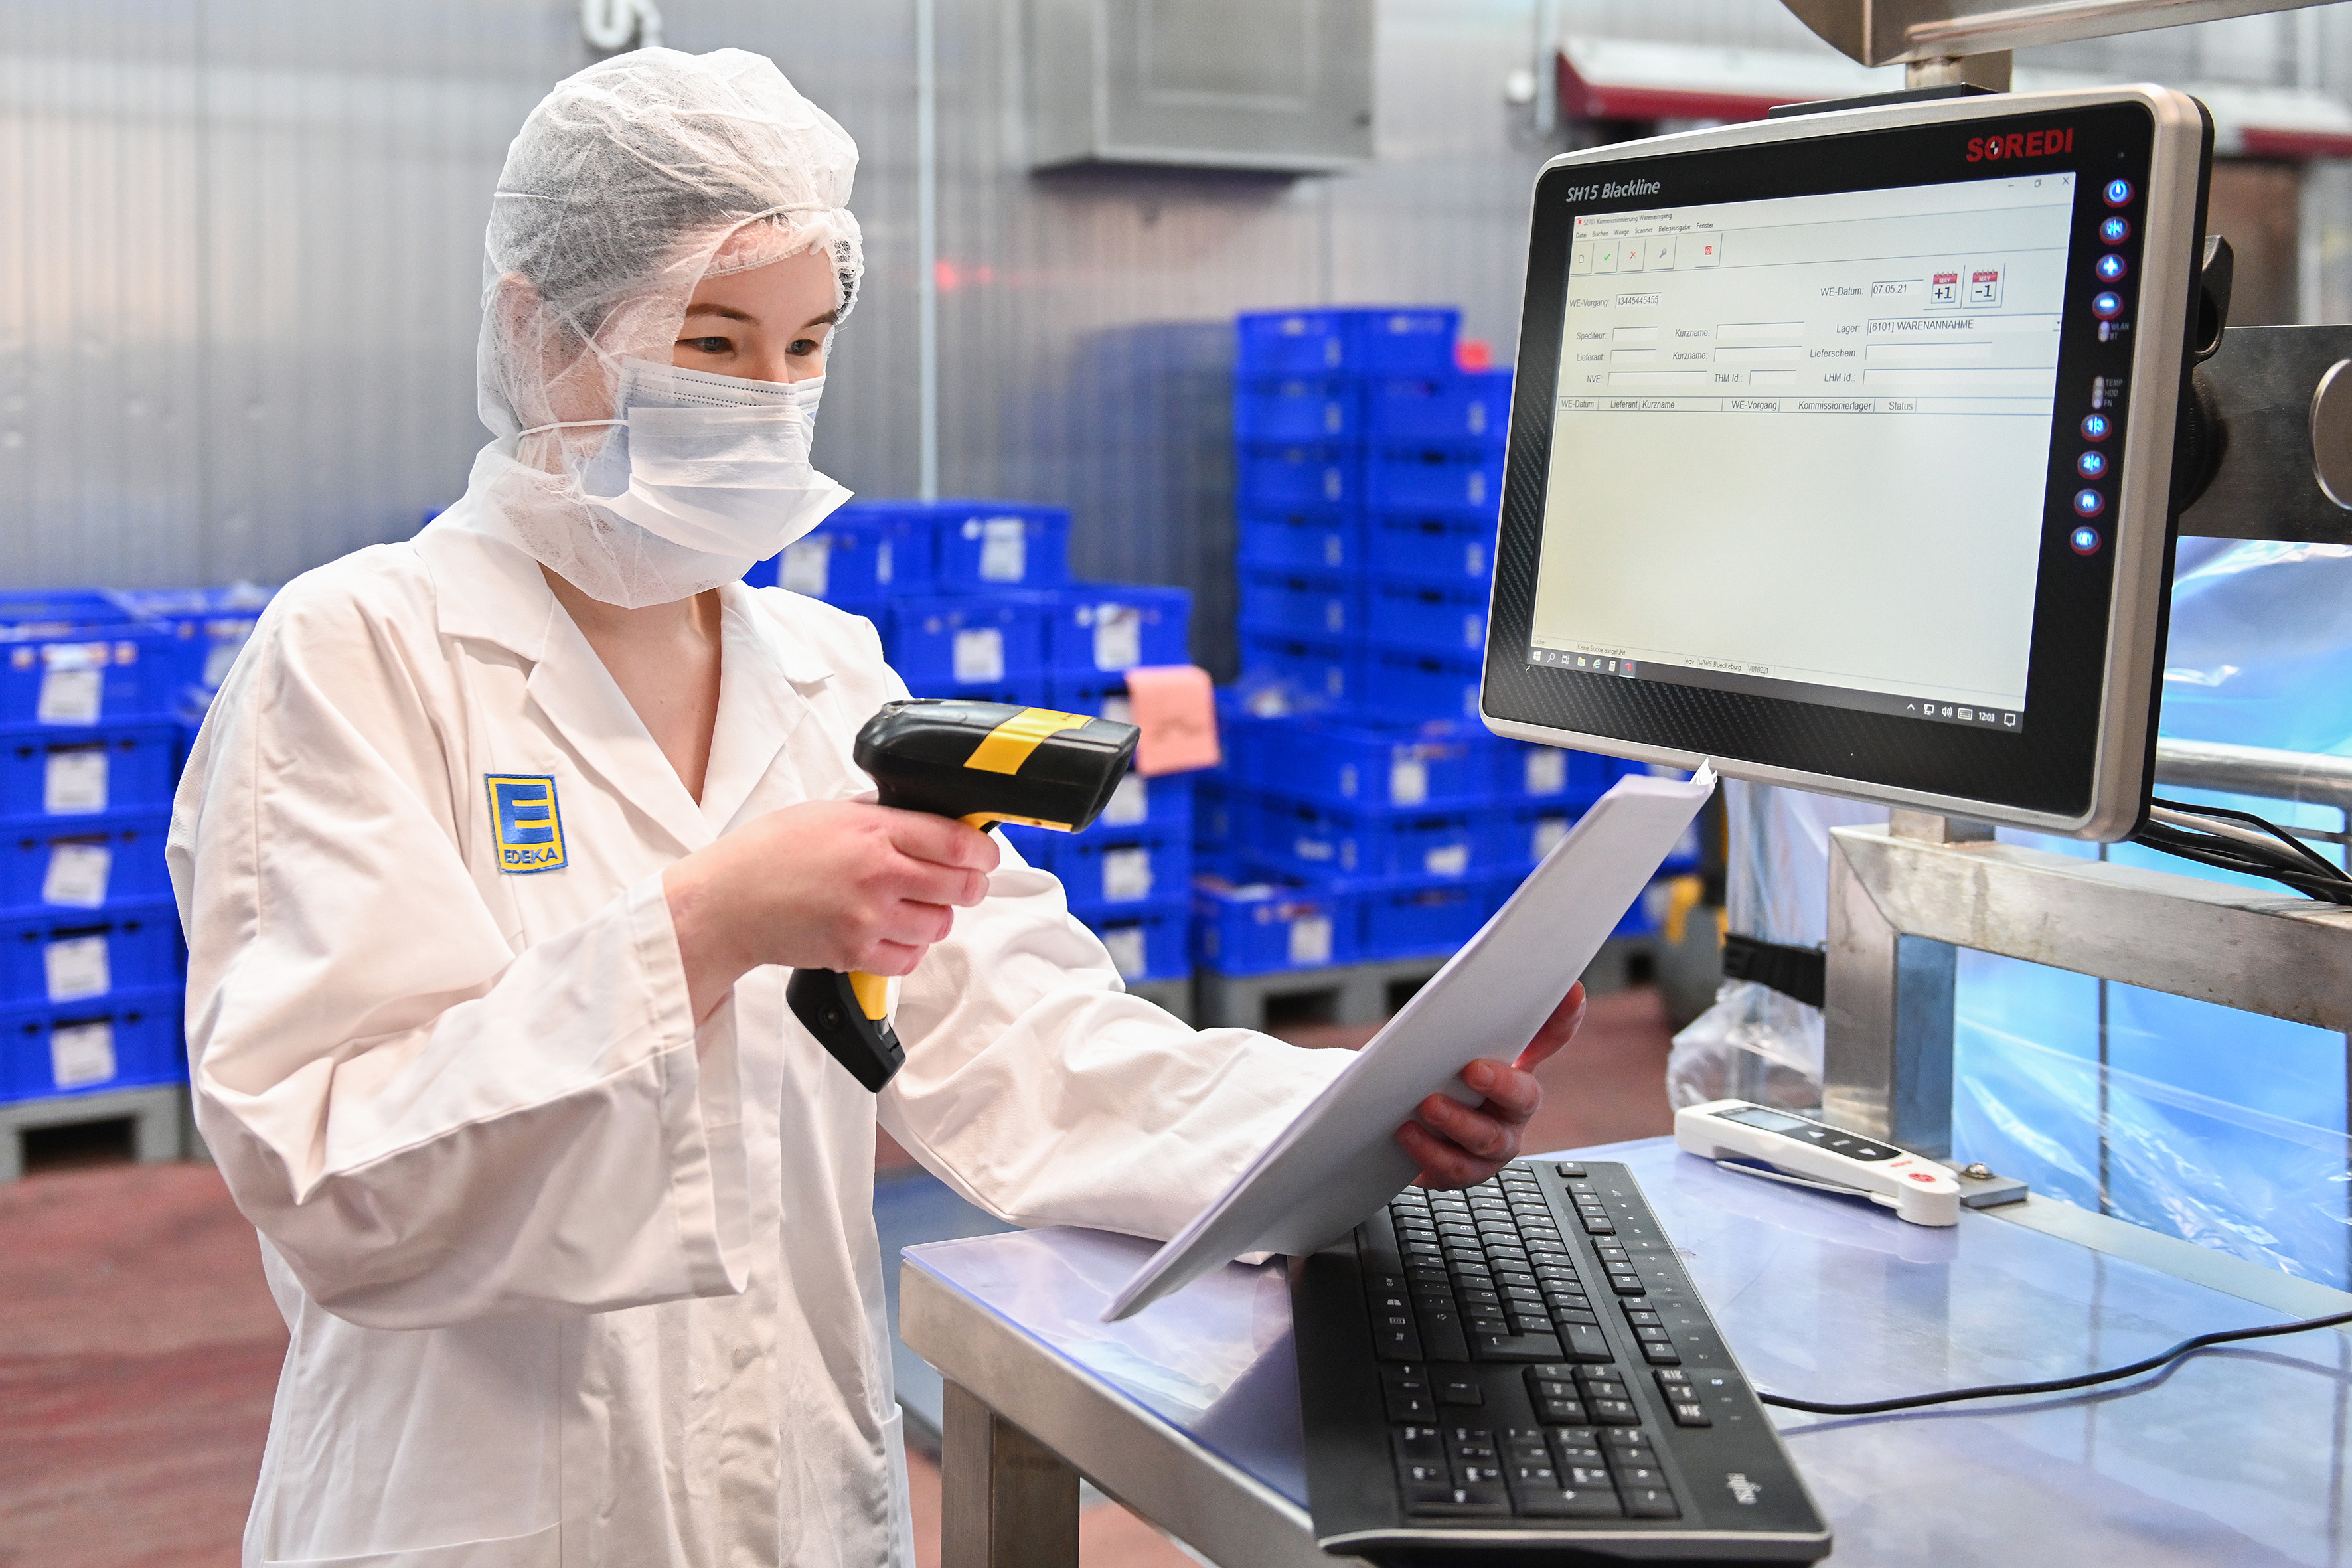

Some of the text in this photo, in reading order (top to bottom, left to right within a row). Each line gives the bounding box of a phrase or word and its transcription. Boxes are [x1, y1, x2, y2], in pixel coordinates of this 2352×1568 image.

[1966, 127, 2074, 162] SOREDI
[1566, 179, 1660, 202] SH15 Blackline
[1597, 216, 1638, 224] Kommissionierung
[1658, 223, 1691, 233] Belegausgabe
[1820, 287, 1864, 297] WE-Datum:
[1873, 284, 1907, 295] 07.05.21
[1934, 286, 1952, 299] +1
[1975, 285, 1992, 297] -1
[1569, 299, 1610, 308] WE-Vorgang:
[1836, 324, 1860, 335] Lager:
[1869, 319, 1974, 333] [6101] WARENANNAHME
[1577, 332, 1607, 341] Spediteur:
[1674, 329, 1710, 337] Kurzname:
[1810, 349, 1858, 358] Lieferschein:
[1715, 374, 1730, 382] THM
[1824, 373, 1842, 382] LHM
[1561, 400, 1594, 408] WE-Datum
[1642, 400, 1675, 408] Kurzname
[1731, 400, 1777, 411] WE-Vorgang
[1798, 400, 1872, 412] Kommissionierlager
[1889, 401, 1913, 410] Status
[1978, 712, 1995, 722] 12:03
[495, 783, 554, 844] E
[504, 847, 558, 864] EDEKA
